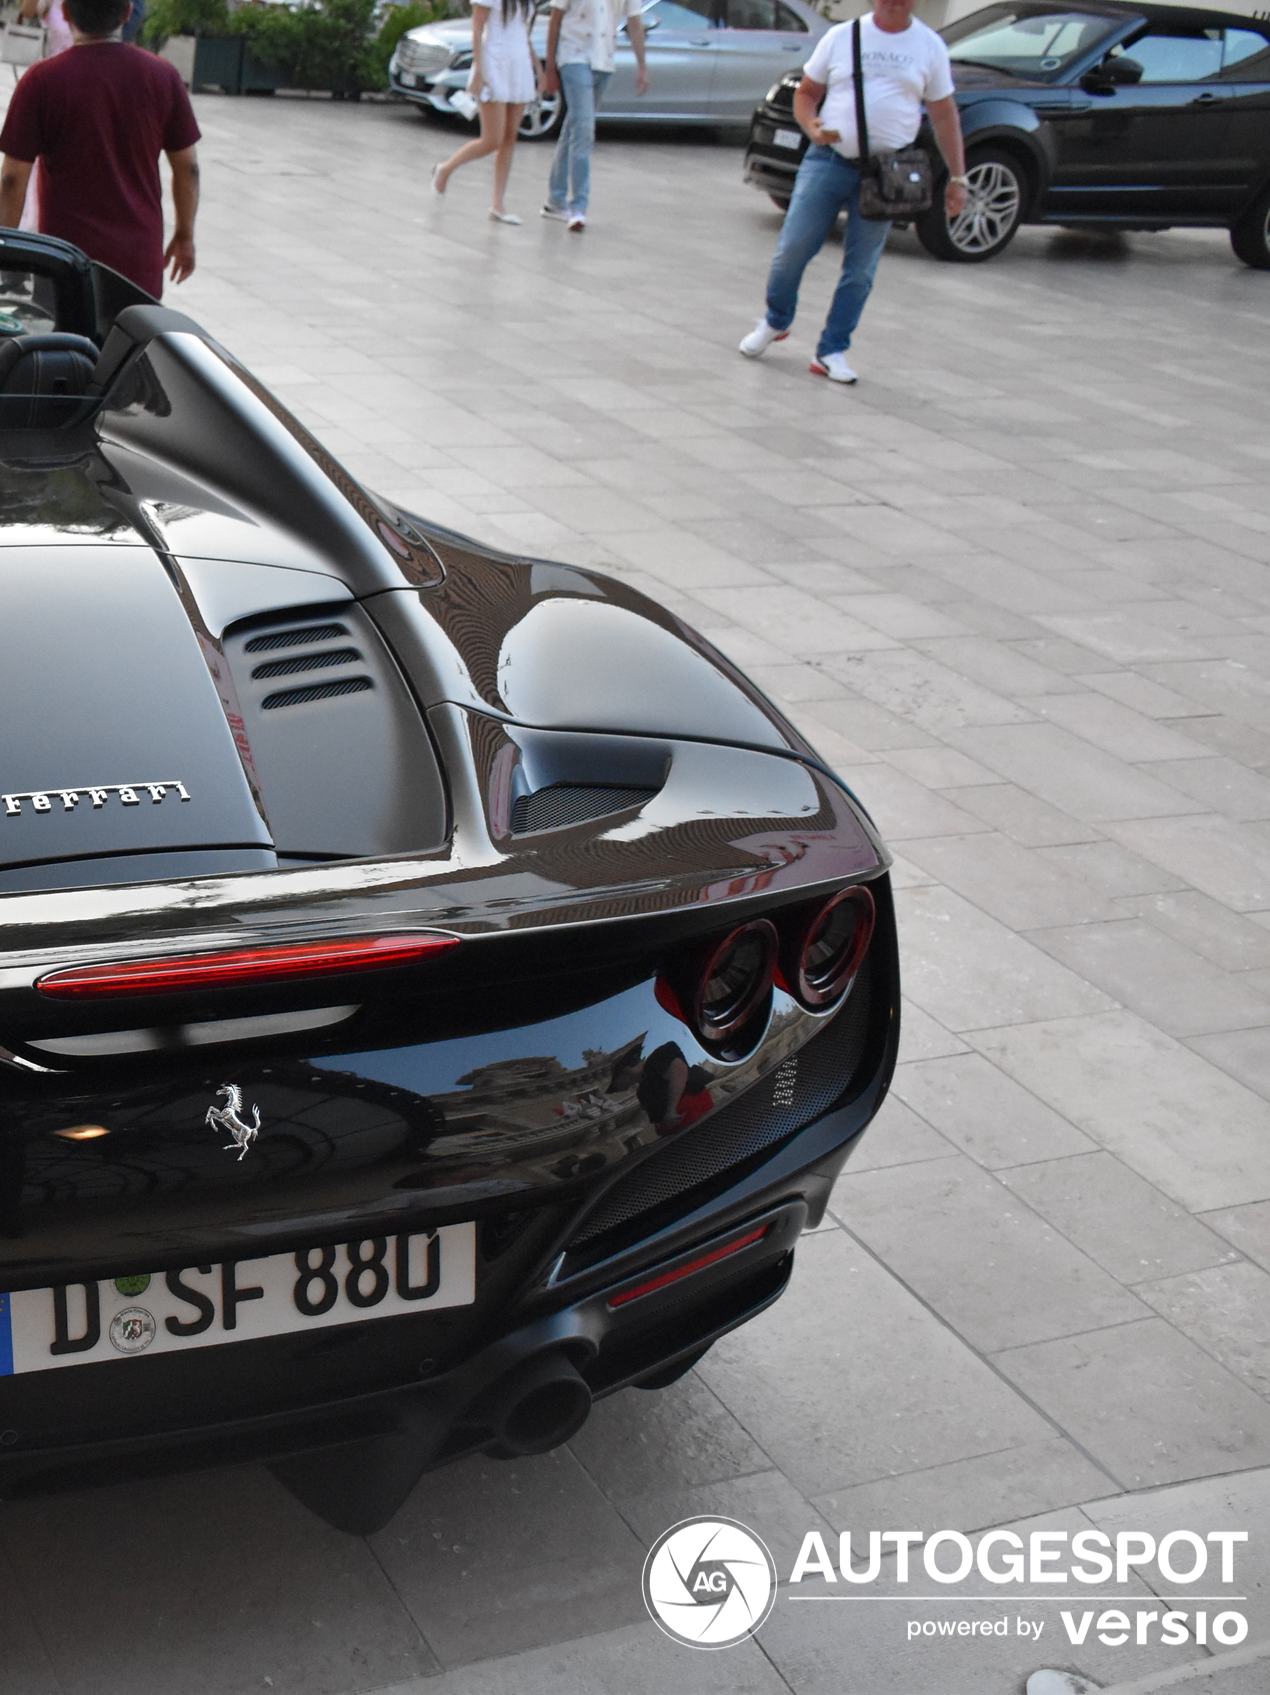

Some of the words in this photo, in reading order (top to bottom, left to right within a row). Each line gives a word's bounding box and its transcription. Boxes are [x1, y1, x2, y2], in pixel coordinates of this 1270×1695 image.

[2, 781, 191, 816] Ferrari
[50, 1281, 101, 1356] D
[165, 1258, 264, 1337] SF
[293, 1229, 440, 1316] 880
